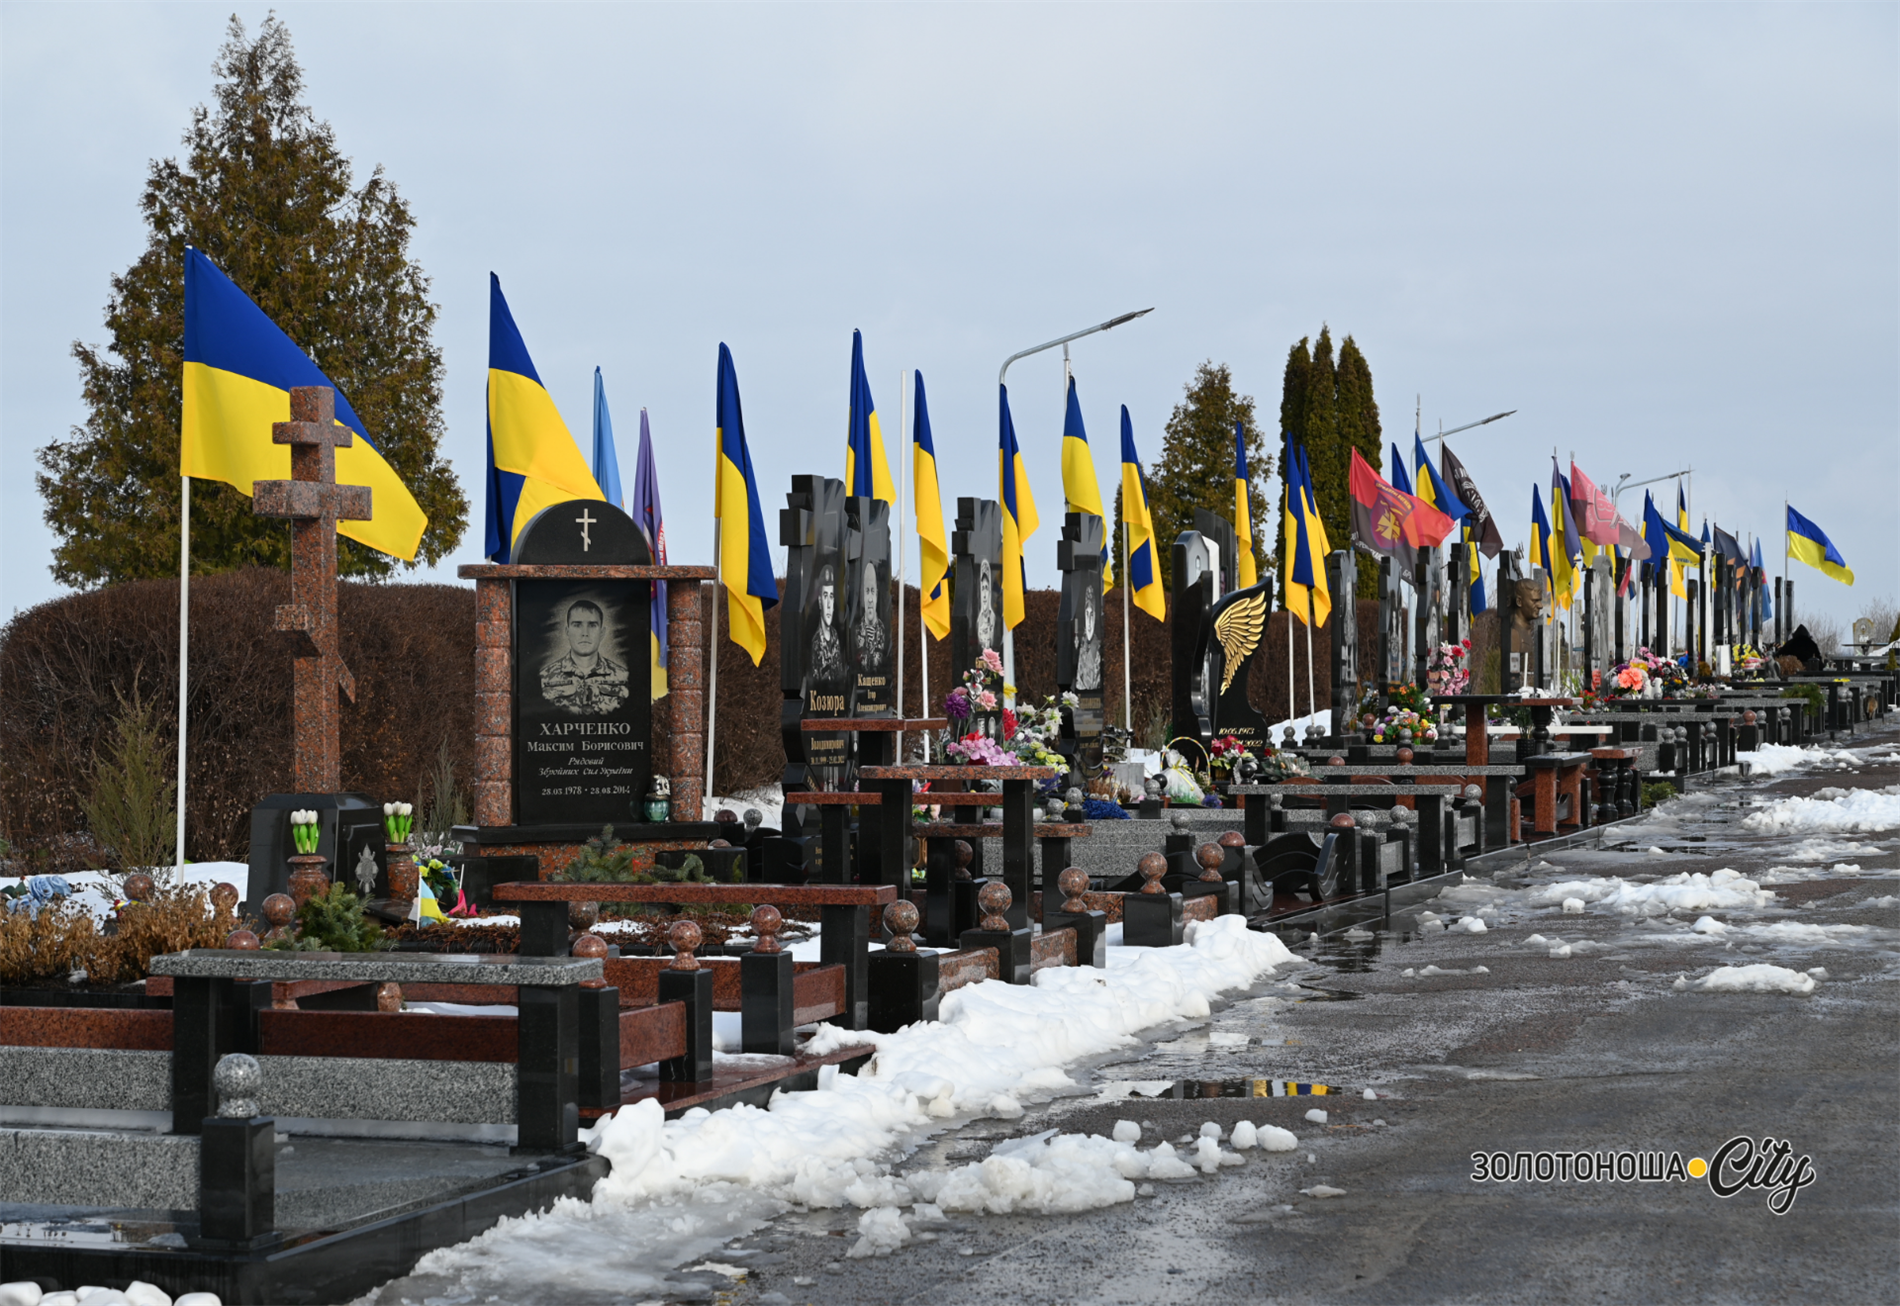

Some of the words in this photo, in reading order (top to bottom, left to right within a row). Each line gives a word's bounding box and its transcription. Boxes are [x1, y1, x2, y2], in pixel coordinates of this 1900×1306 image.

[857, 673, 887, 688] Кащенко
[809, 690, 845, 716] Козюра
[539, 722, 631, 736] ХАРЧЕНКО
[527, 741, 575, 752] Максим
[581, 740, 644, 752] Борисович
[567, 757, 605, 766] Рядовий
[538, 766, 580, 778] Збройних
[582, 767, 599, 776] Сил
[600, 766, 634, 778] України
